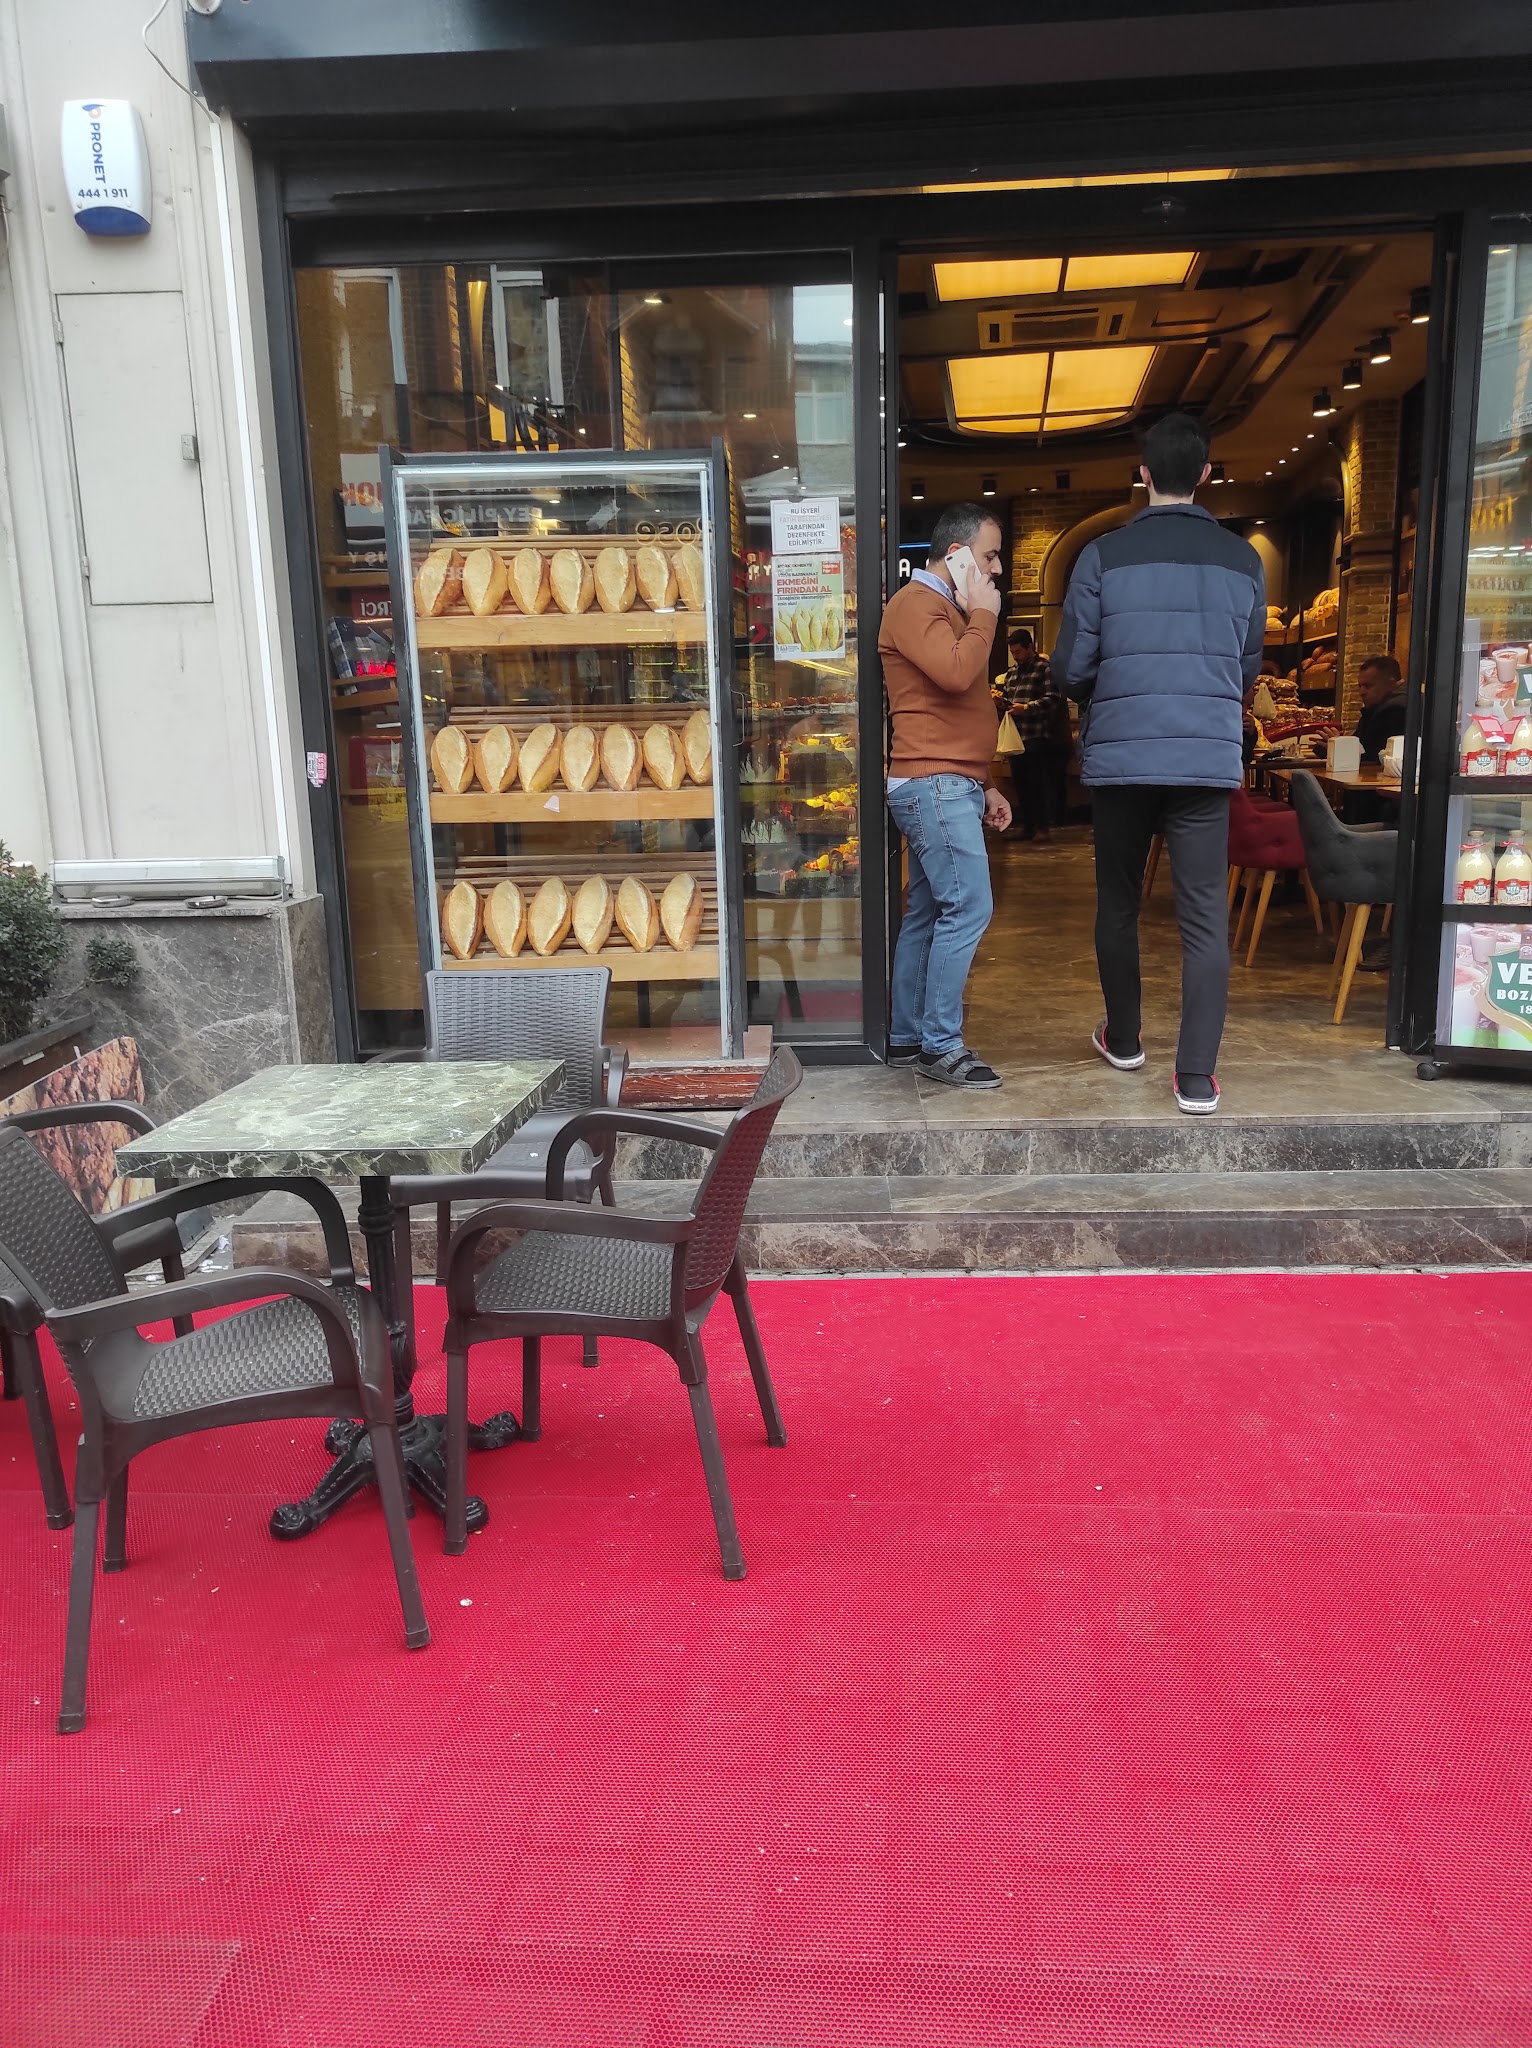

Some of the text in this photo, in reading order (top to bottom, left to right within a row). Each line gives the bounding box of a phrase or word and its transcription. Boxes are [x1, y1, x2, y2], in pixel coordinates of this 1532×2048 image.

[90, 122, 106, 184] PRONET
[78, 189, 128, 198] 444 1 911
[800, 506, 820, 515] İŞYERİ
[786, 523, 825, 531] TARAFINDAN
[787, 531, 825, 539] DEZENFEKTE
[788, 539, 824, 547] EDİLMİŞTİR.
[777, 576, 818, 586] EKMEĞİNİ
[777, 585, 832, 594] FIRINDAN AL
[1497, 989, 1532, 1001] BOZ
